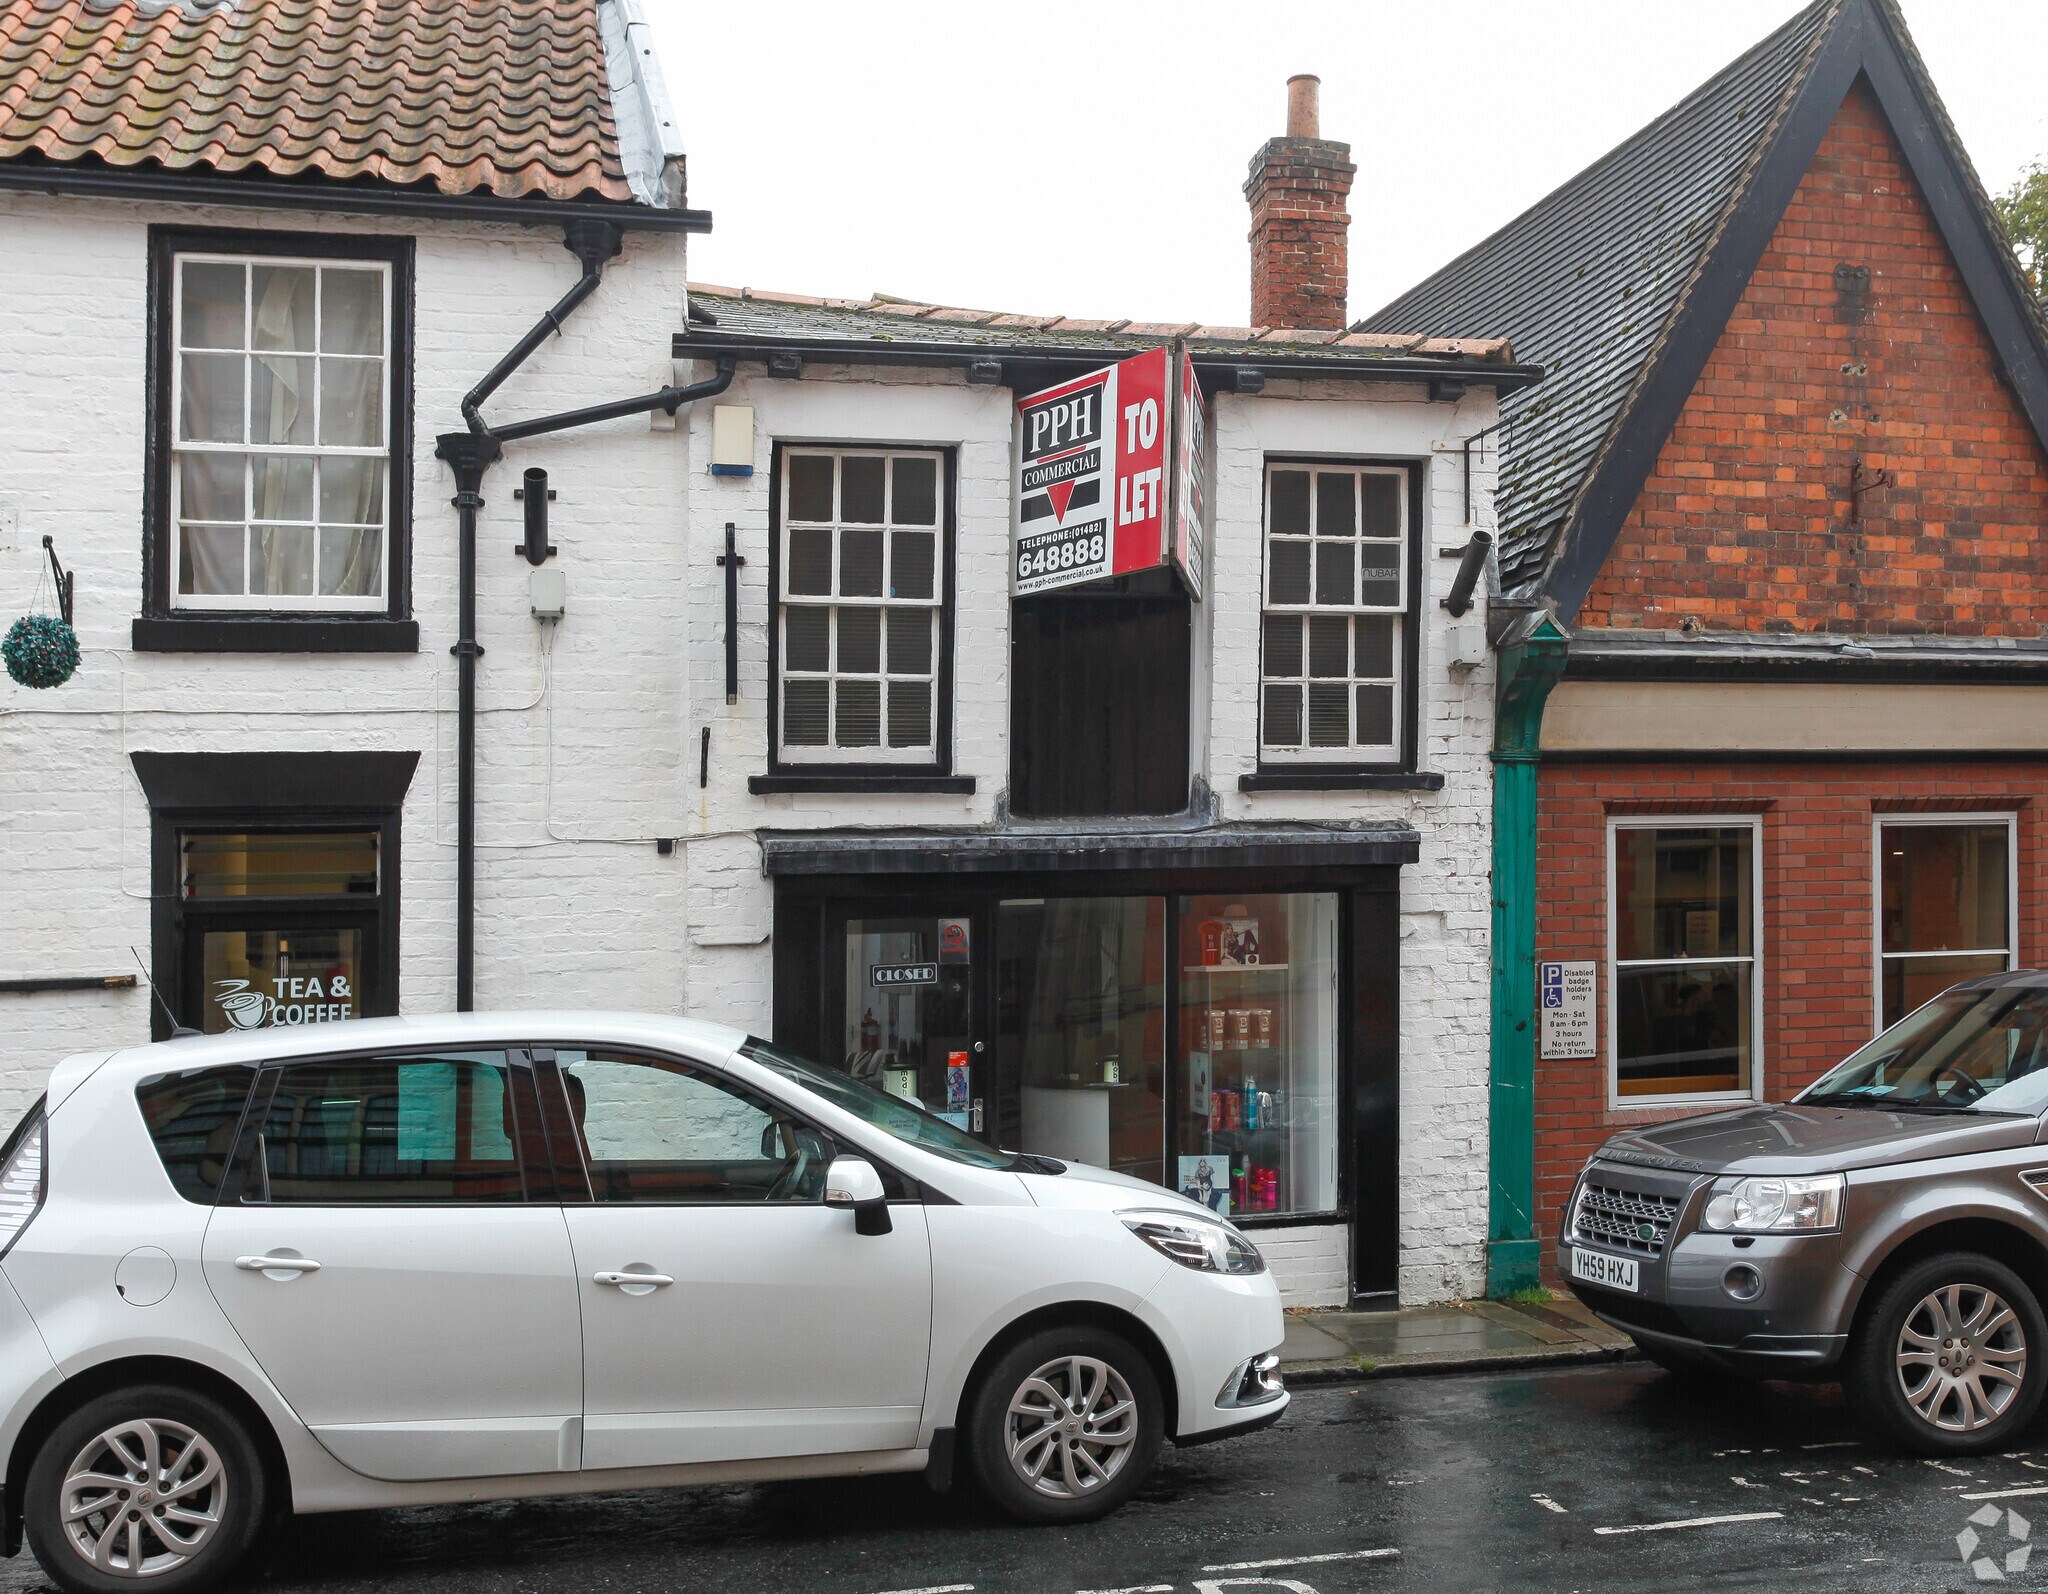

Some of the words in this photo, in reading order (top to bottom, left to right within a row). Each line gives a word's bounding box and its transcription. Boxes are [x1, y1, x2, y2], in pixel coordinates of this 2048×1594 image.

[1030, 394, 1094, 453] PPH
[1125, 398, 1158, 454] TO
[1025, 454, 1098, 487] COMMERCIAL
[1119, 466, 1162, 527] LET
[1018, 535, 1104, 577] 648888
[1018, 565, 1103, 591] www.pph-commercial.co.uk
[272, 977, 324, 999] TEA
[330, 975, 352, 997] &
[876, 967, 934, 982] CLOSED
[1548, 966, 1560, 984] P
[1568, 978, 1590, 986] badge
[1571, 994, 1587, 1002] only
[1573, 1010, 1586, 1018] Sat
[1605, 1150, 1640, 1161] LAND
[1645, 1156, 1703, 1170] ROVER
[1576, 1251, 1605, 1280] YH59
[1608, 1259, 1633, 1287] HXJ
